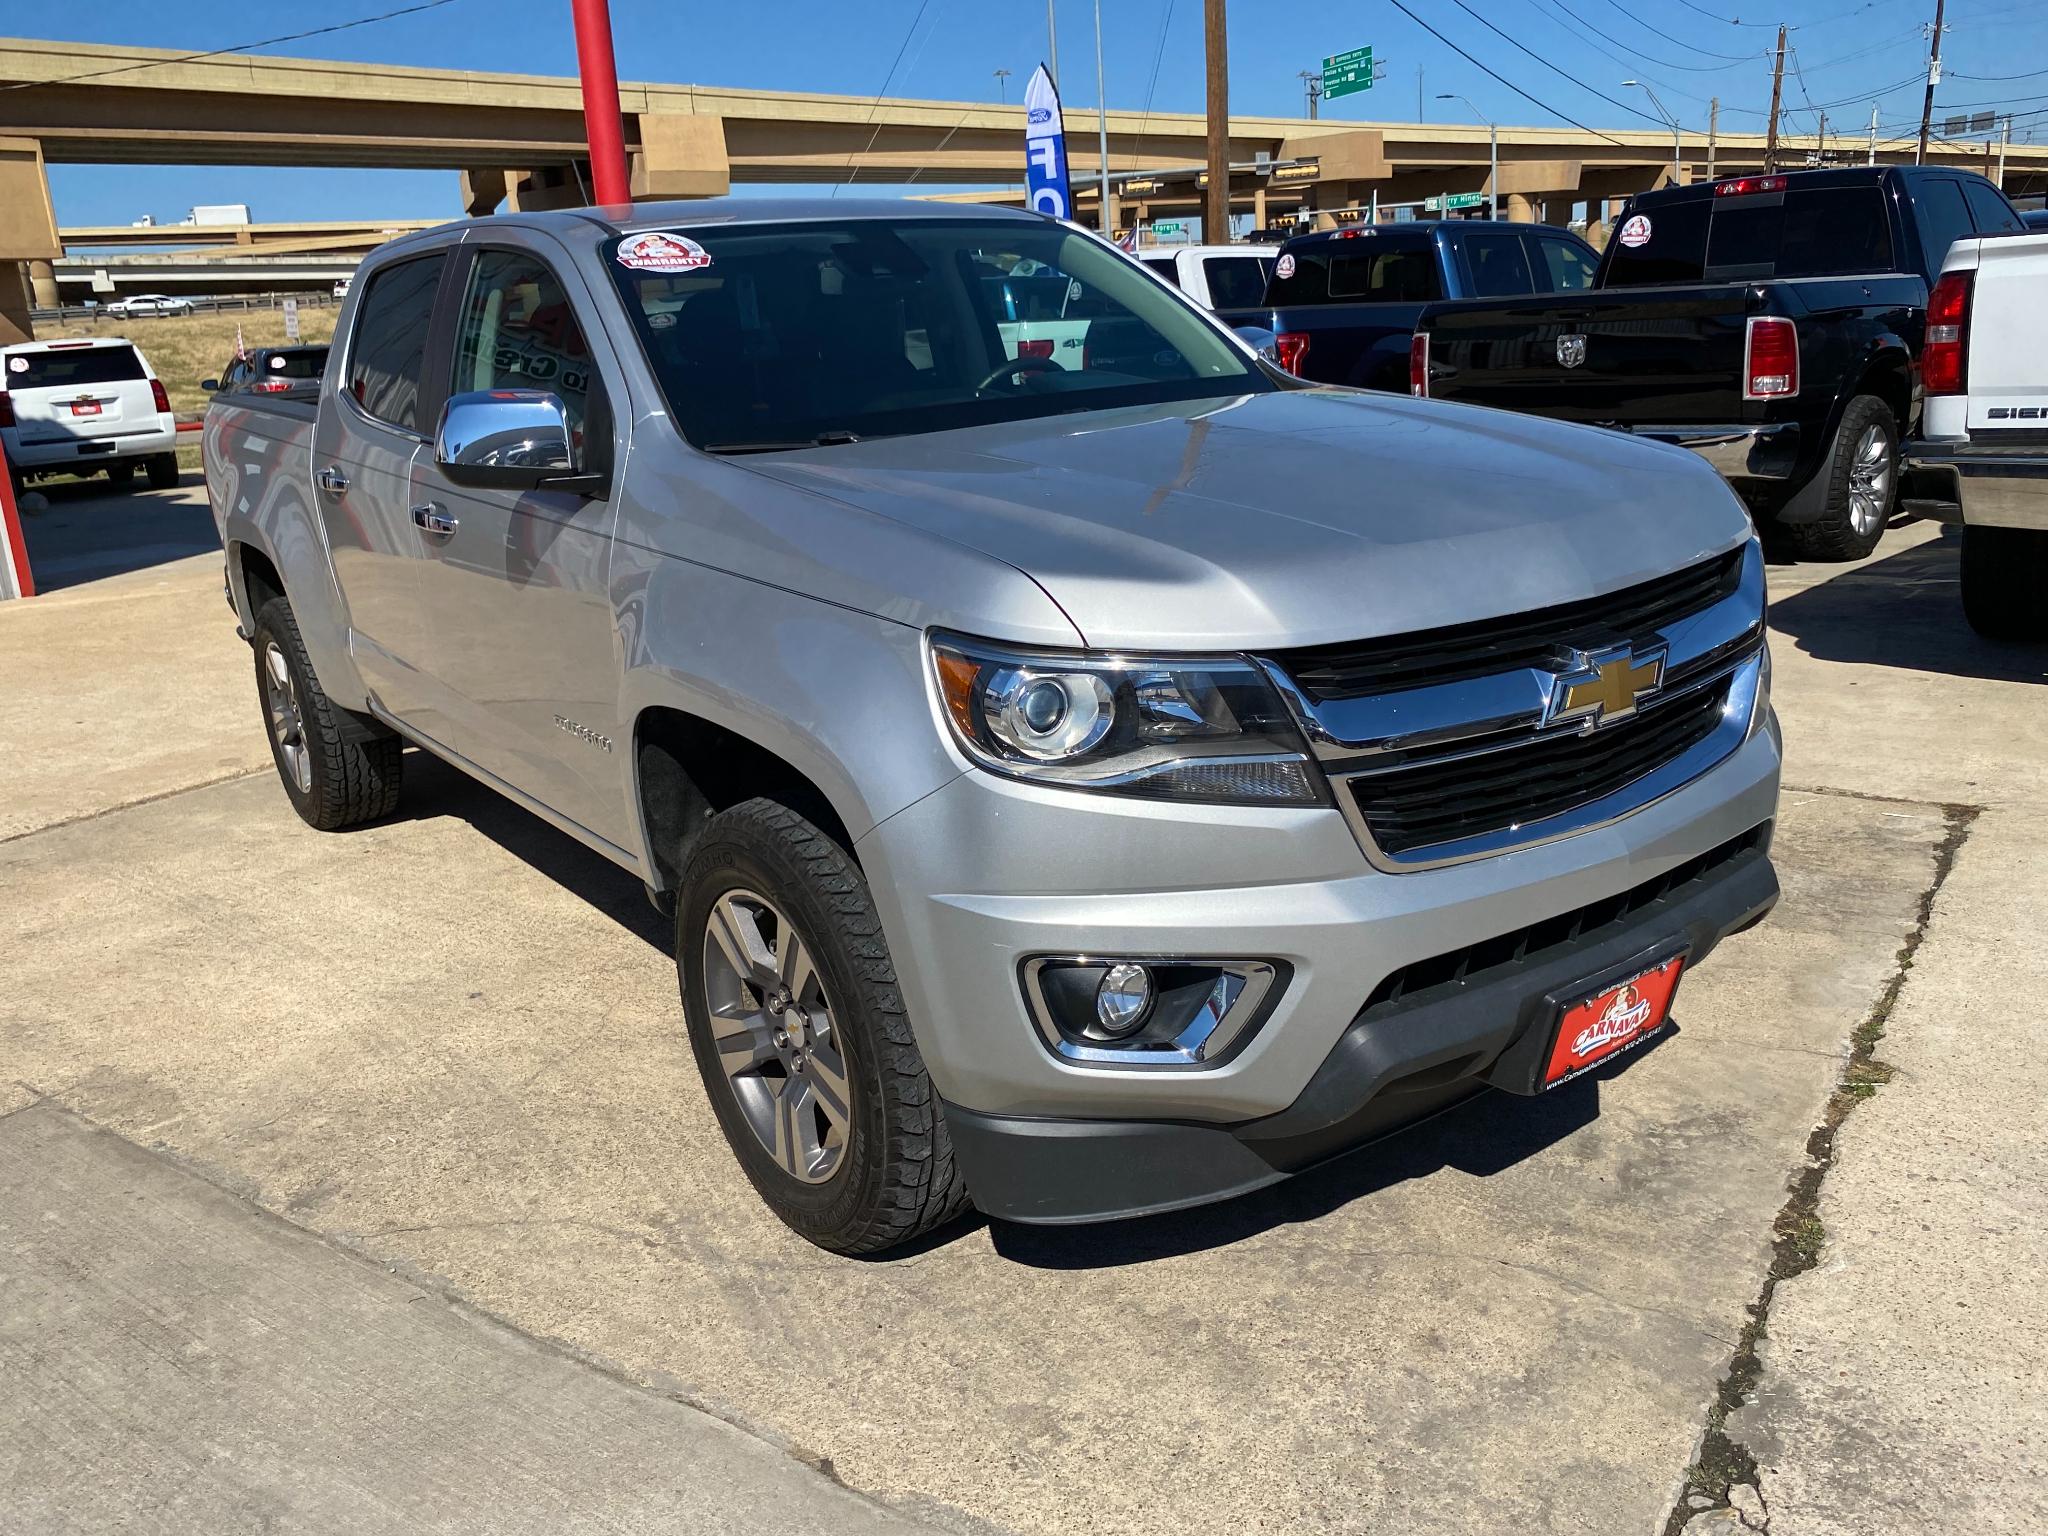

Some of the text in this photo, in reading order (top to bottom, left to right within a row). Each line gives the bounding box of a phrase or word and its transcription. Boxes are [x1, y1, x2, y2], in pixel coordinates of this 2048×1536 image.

[1460, 195, 1480, 203] Hines
[628, 257, 702, 267] WARRANTY
[1572, 1003, 1650, 1051] CARNAVAL
